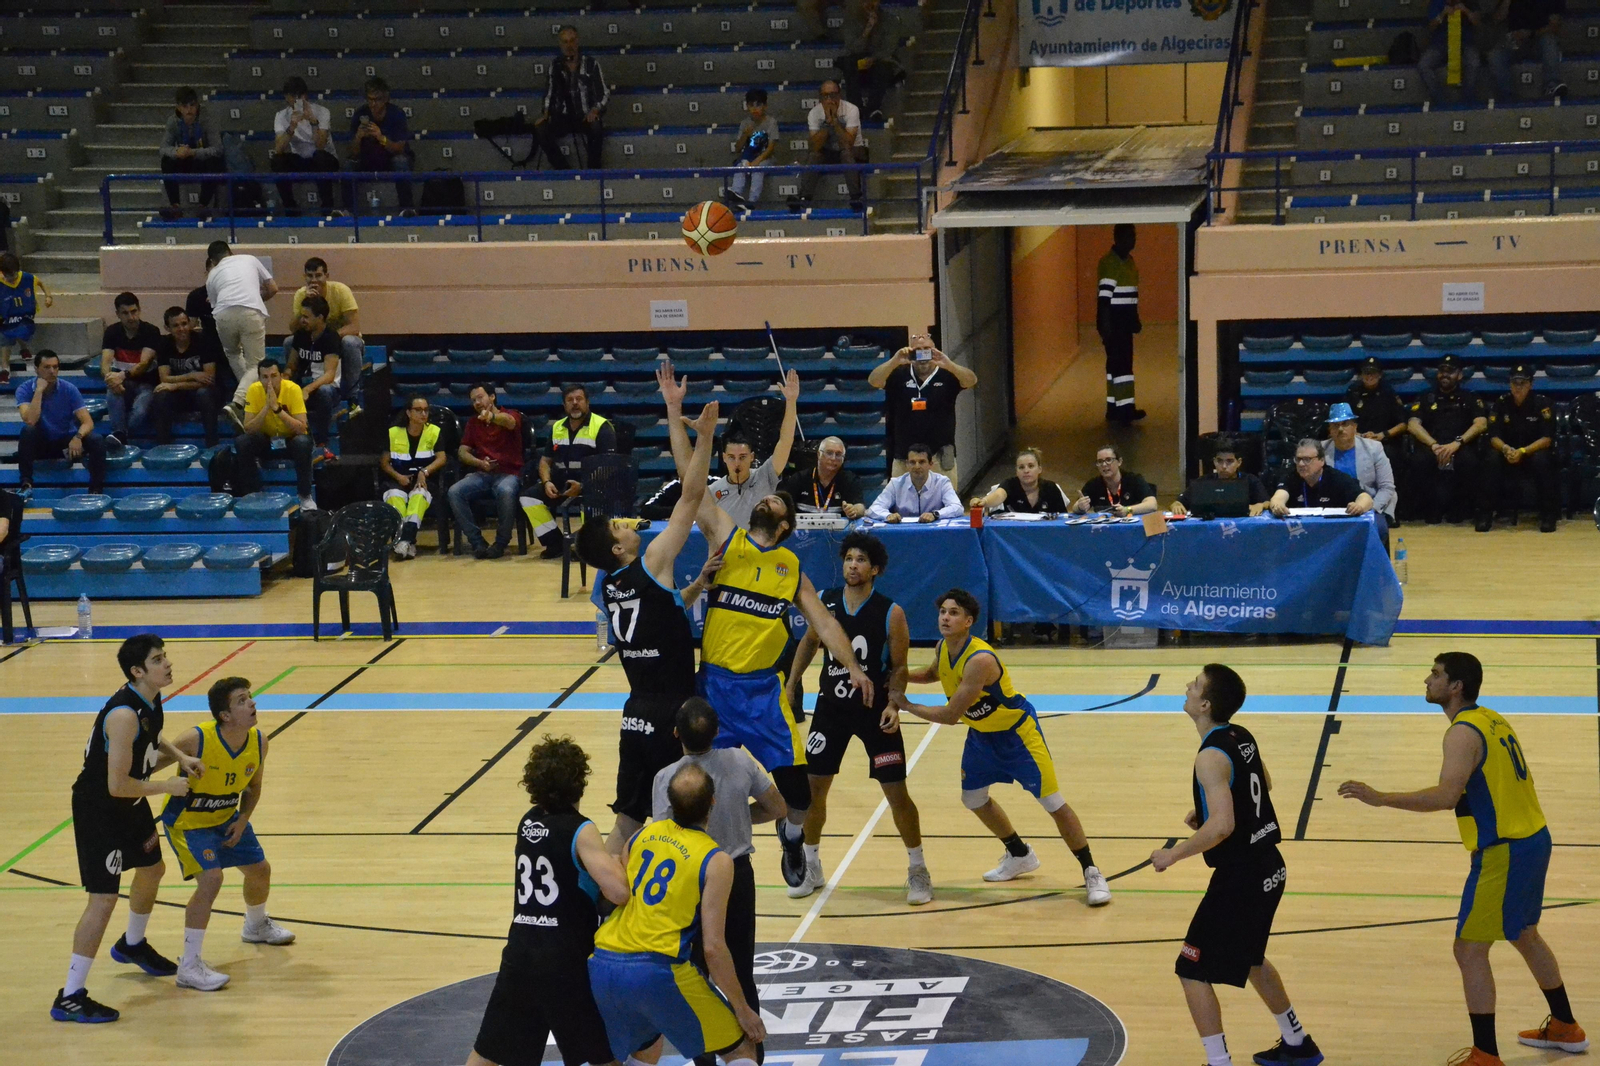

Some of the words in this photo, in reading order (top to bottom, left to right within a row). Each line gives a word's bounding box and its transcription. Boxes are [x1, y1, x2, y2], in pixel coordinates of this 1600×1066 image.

[1074, 0, 1095, 11] de
[1102, 0, 1182, 14] Deportes
[1030, 38, 1136, 58] Ayuntamiento
[1141, 38, 1157, 51] de
[1161, 34, 1230, 54] Algeciras
[1319, 238, 1406, 254] PRENSA
[1492, 235, 1521, 250] TV
[628, 258, 709, 272] PRENSA
[786, 254, 816, 268] TV
[14, 296, 23, 307] 11
[756, 567, 761, 582] 1
[1161, 580, 1277, 600] Ayuntamiento
[1161, 602, 1179, 615] de
[1184, 600, 1276, 620] Algeciras
[608, 598, 641, 644] 17
[1499, 734, 1527, 782] 10
[225, 773, 236, 786] 13
[1250, 772, 1262, 818] 9
[659, 835, 690, 860] IGUALADA
[517, 854, 560, 906] 33
[632, 849, 676, 906] 18
[806, 1029, 938, 1045] FASE
